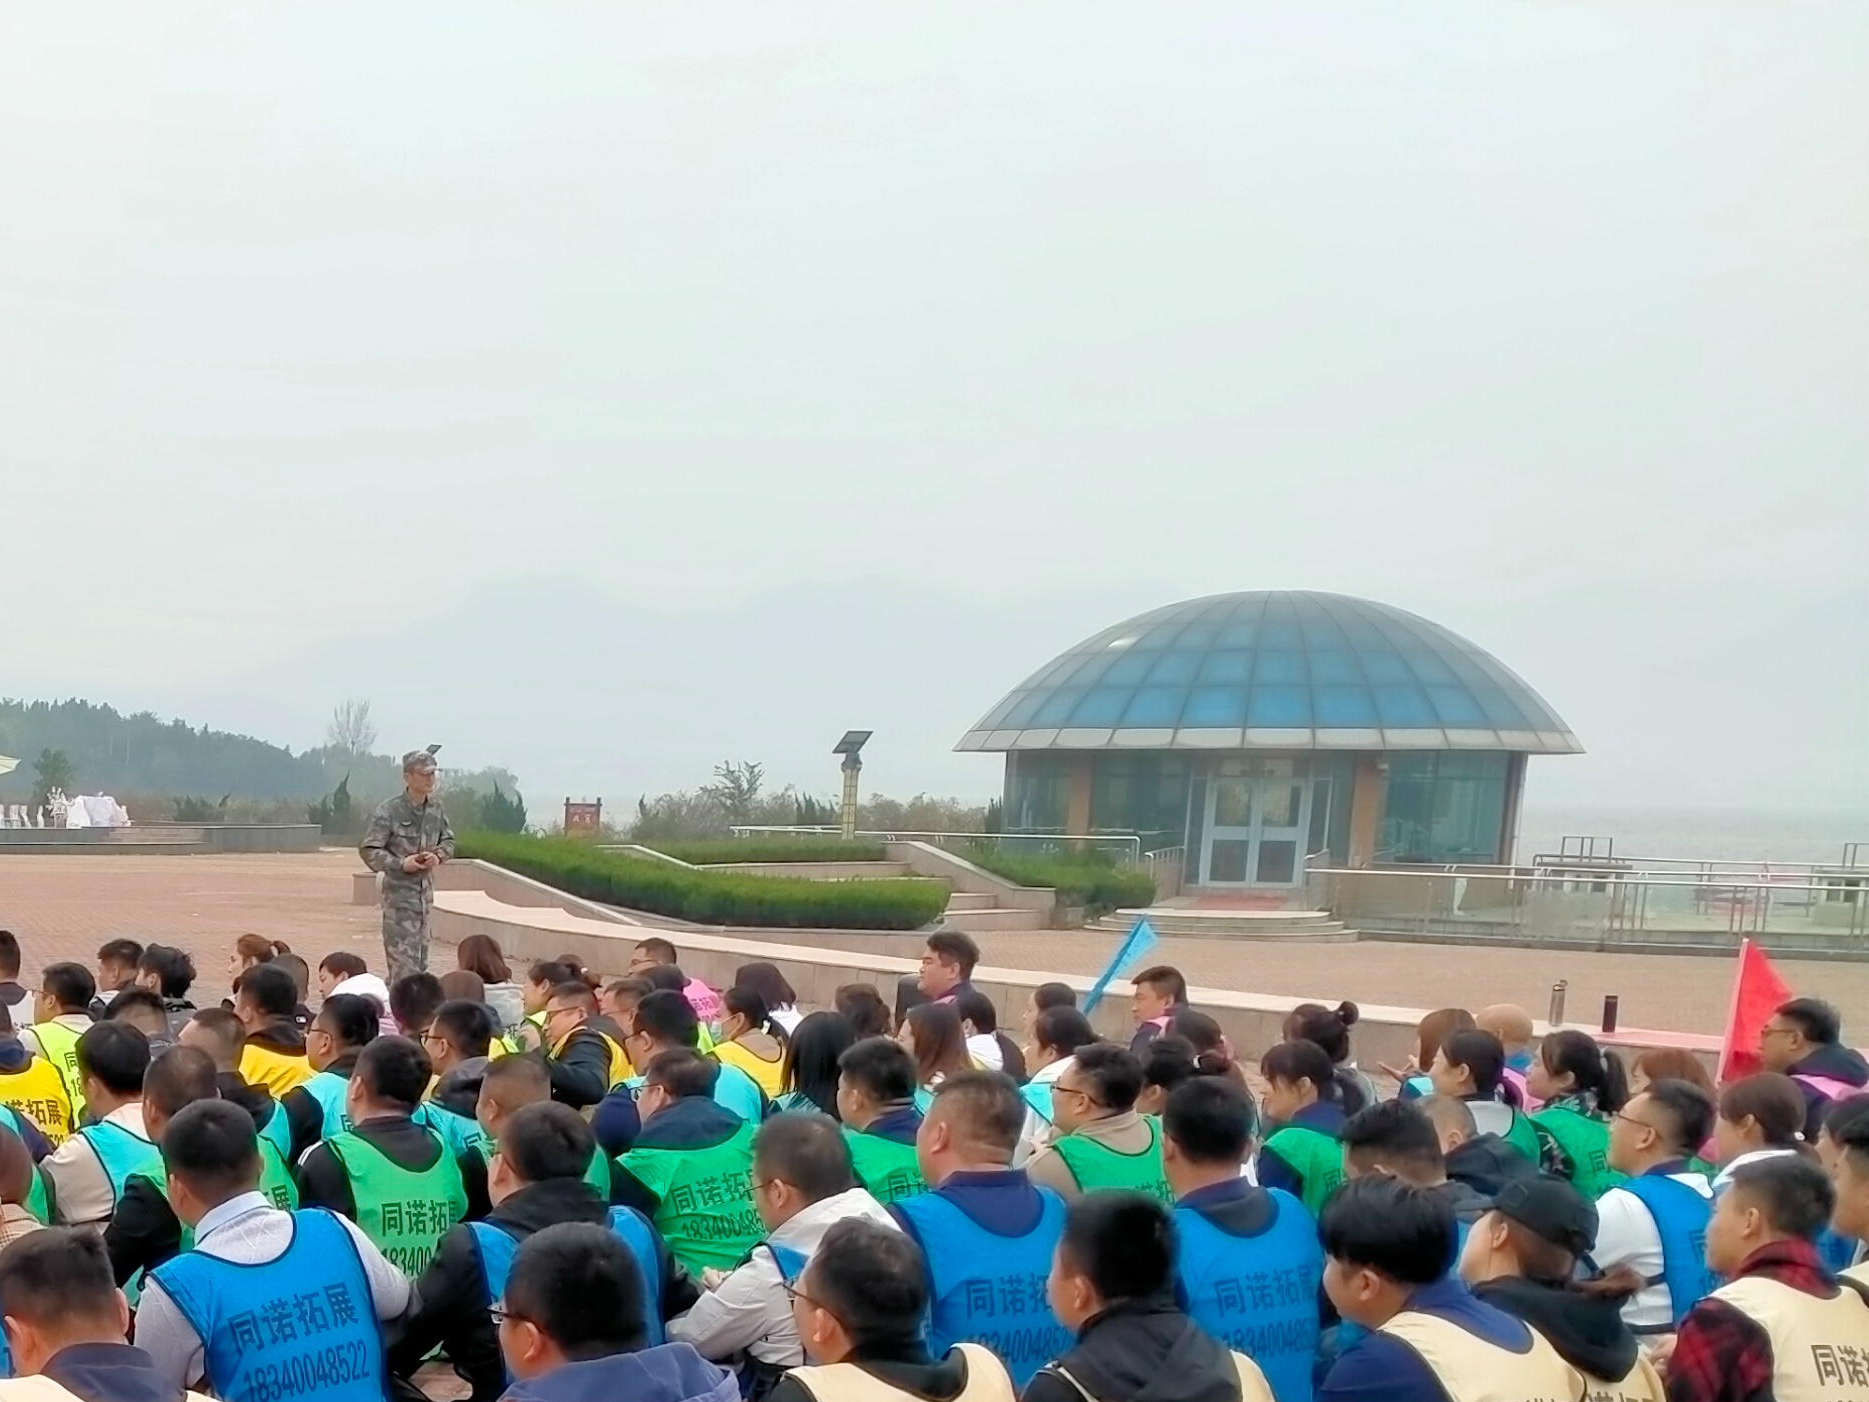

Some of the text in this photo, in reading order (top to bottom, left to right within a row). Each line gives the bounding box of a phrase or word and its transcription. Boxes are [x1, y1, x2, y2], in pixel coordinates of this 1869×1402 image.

[226, 1281, 359, 1357] 同诺拓展
[1810, 1344, 1869, 1388] 同诺
